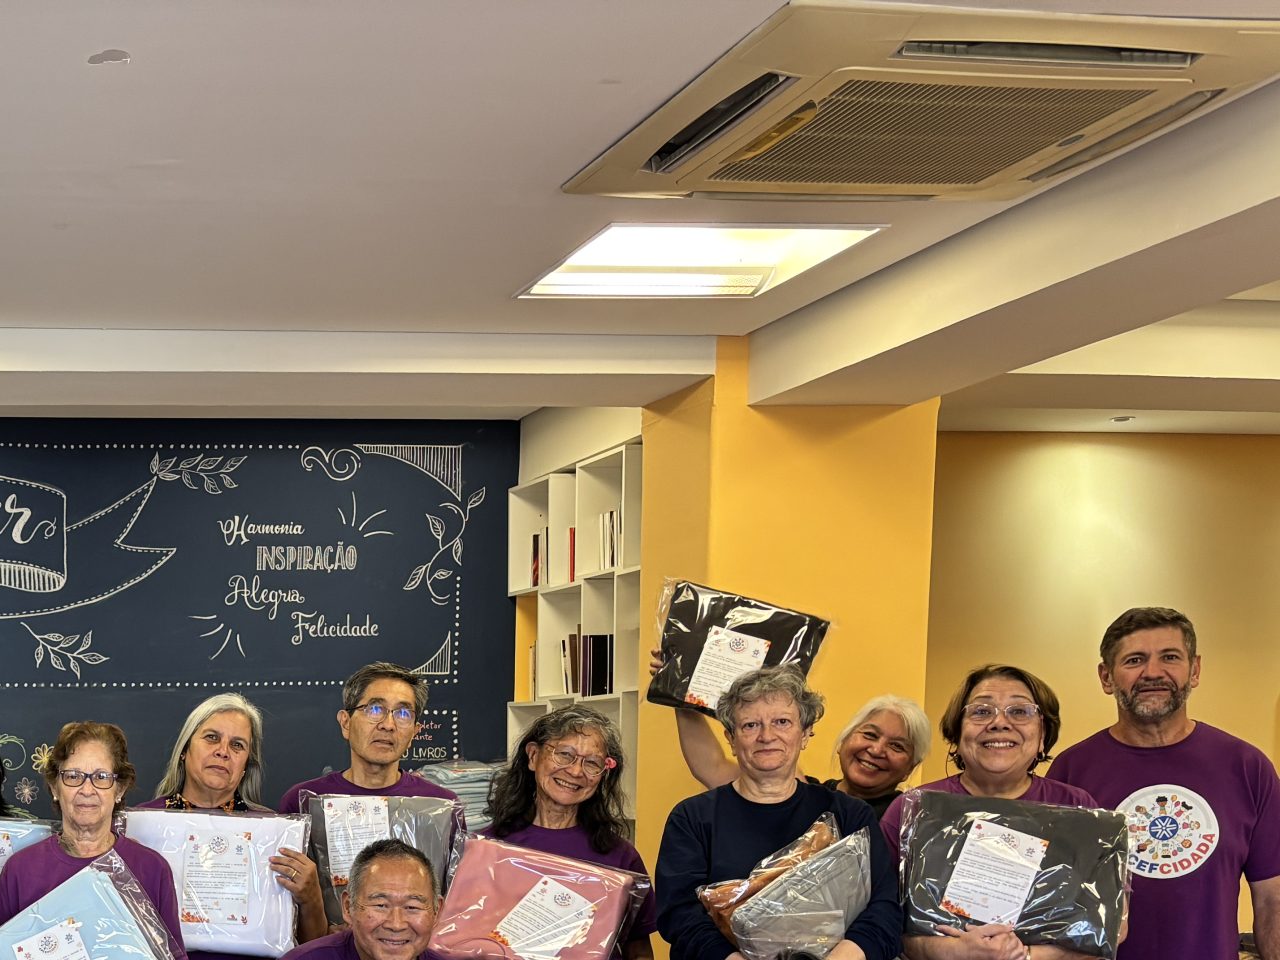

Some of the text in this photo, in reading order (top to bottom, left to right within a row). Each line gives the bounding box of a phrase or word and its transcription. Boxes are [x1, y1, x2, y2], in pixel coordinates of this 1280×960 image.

[217, 514, 305, 546] Harmonia
[256, 541, 358, 573] INSPIRAÇÃO
[225, 574, 306, 620] Alegria
[290, 610, 380, 646] Felicidade
[412, 746, 447, 759] LIVROS
